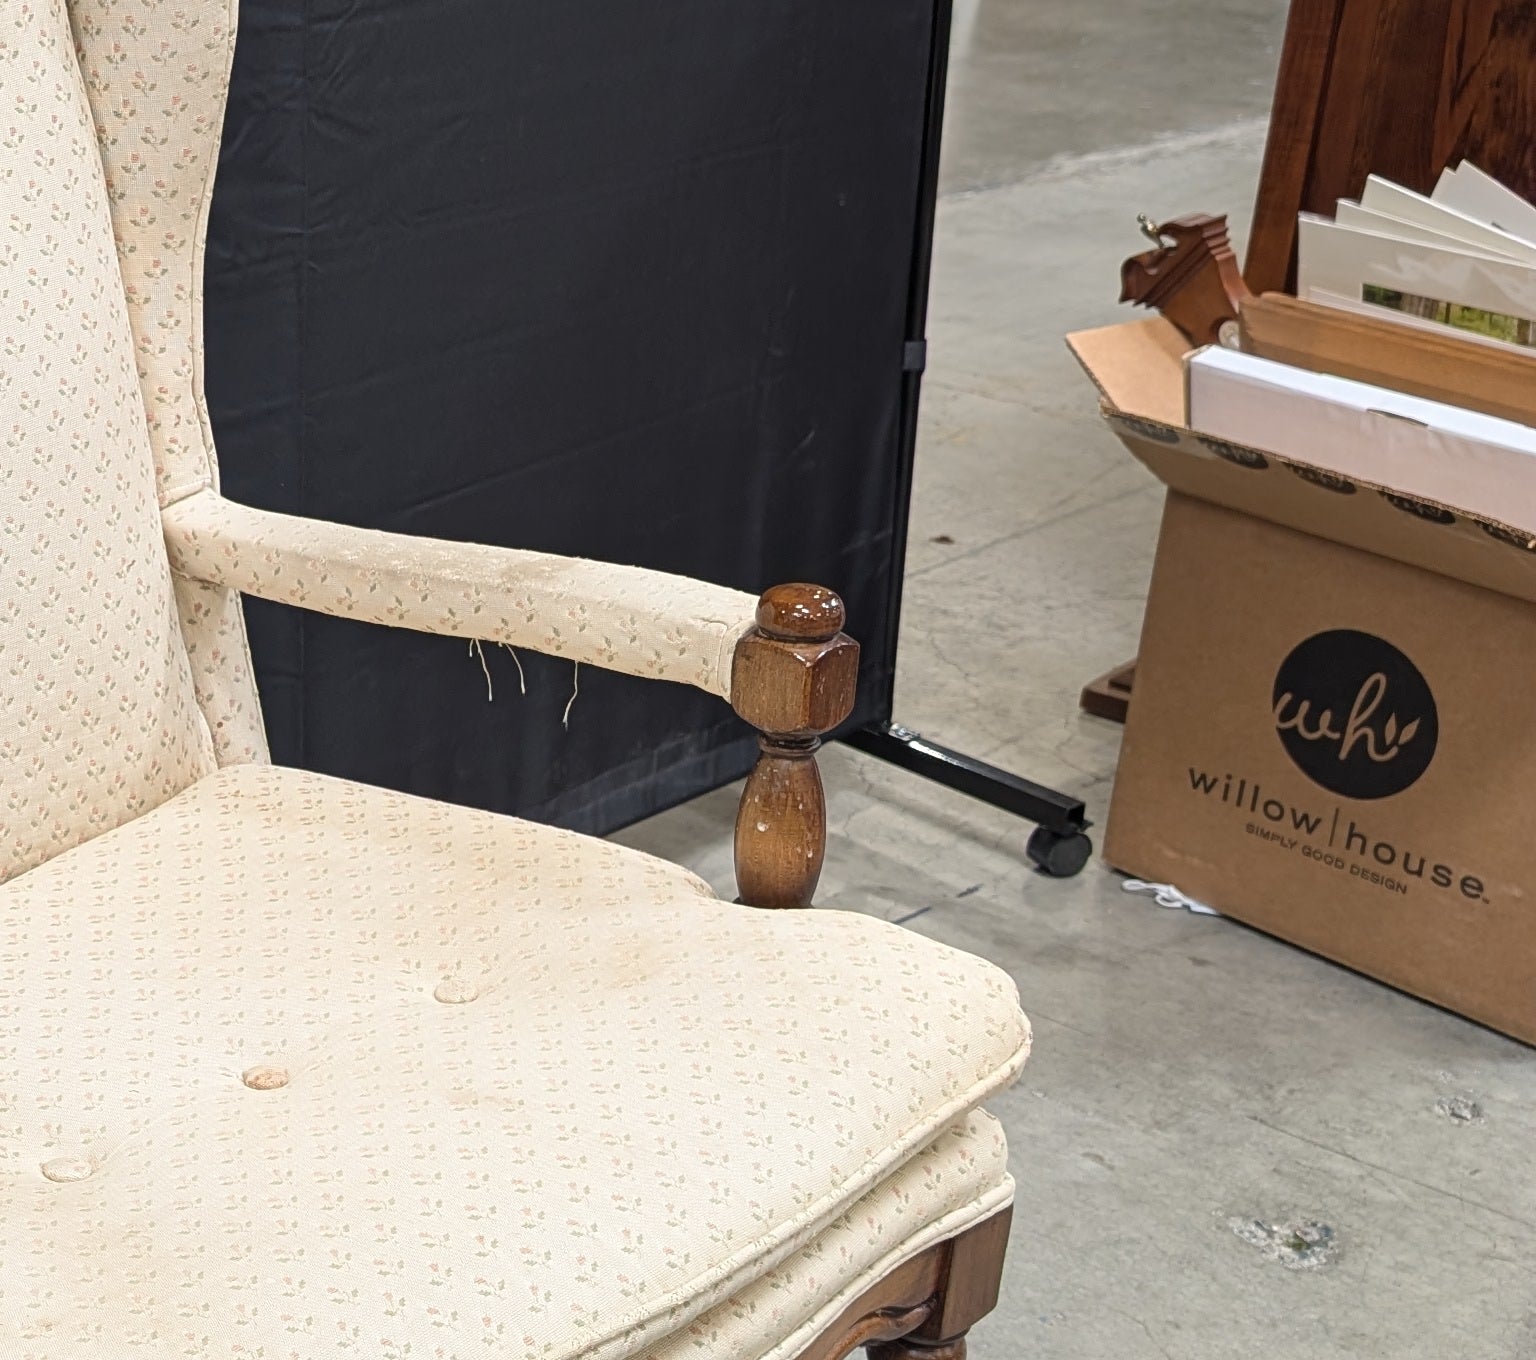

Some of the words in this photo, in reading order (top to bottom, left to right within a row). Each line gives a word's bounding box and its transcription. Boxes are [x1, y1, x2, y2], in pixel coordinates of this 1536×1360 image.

[1245, 823, 1297, 849] SIMPLY
[1301, 845, 1345, 870] GOOD
[1349, 864, 1407, 895] DESIGN
